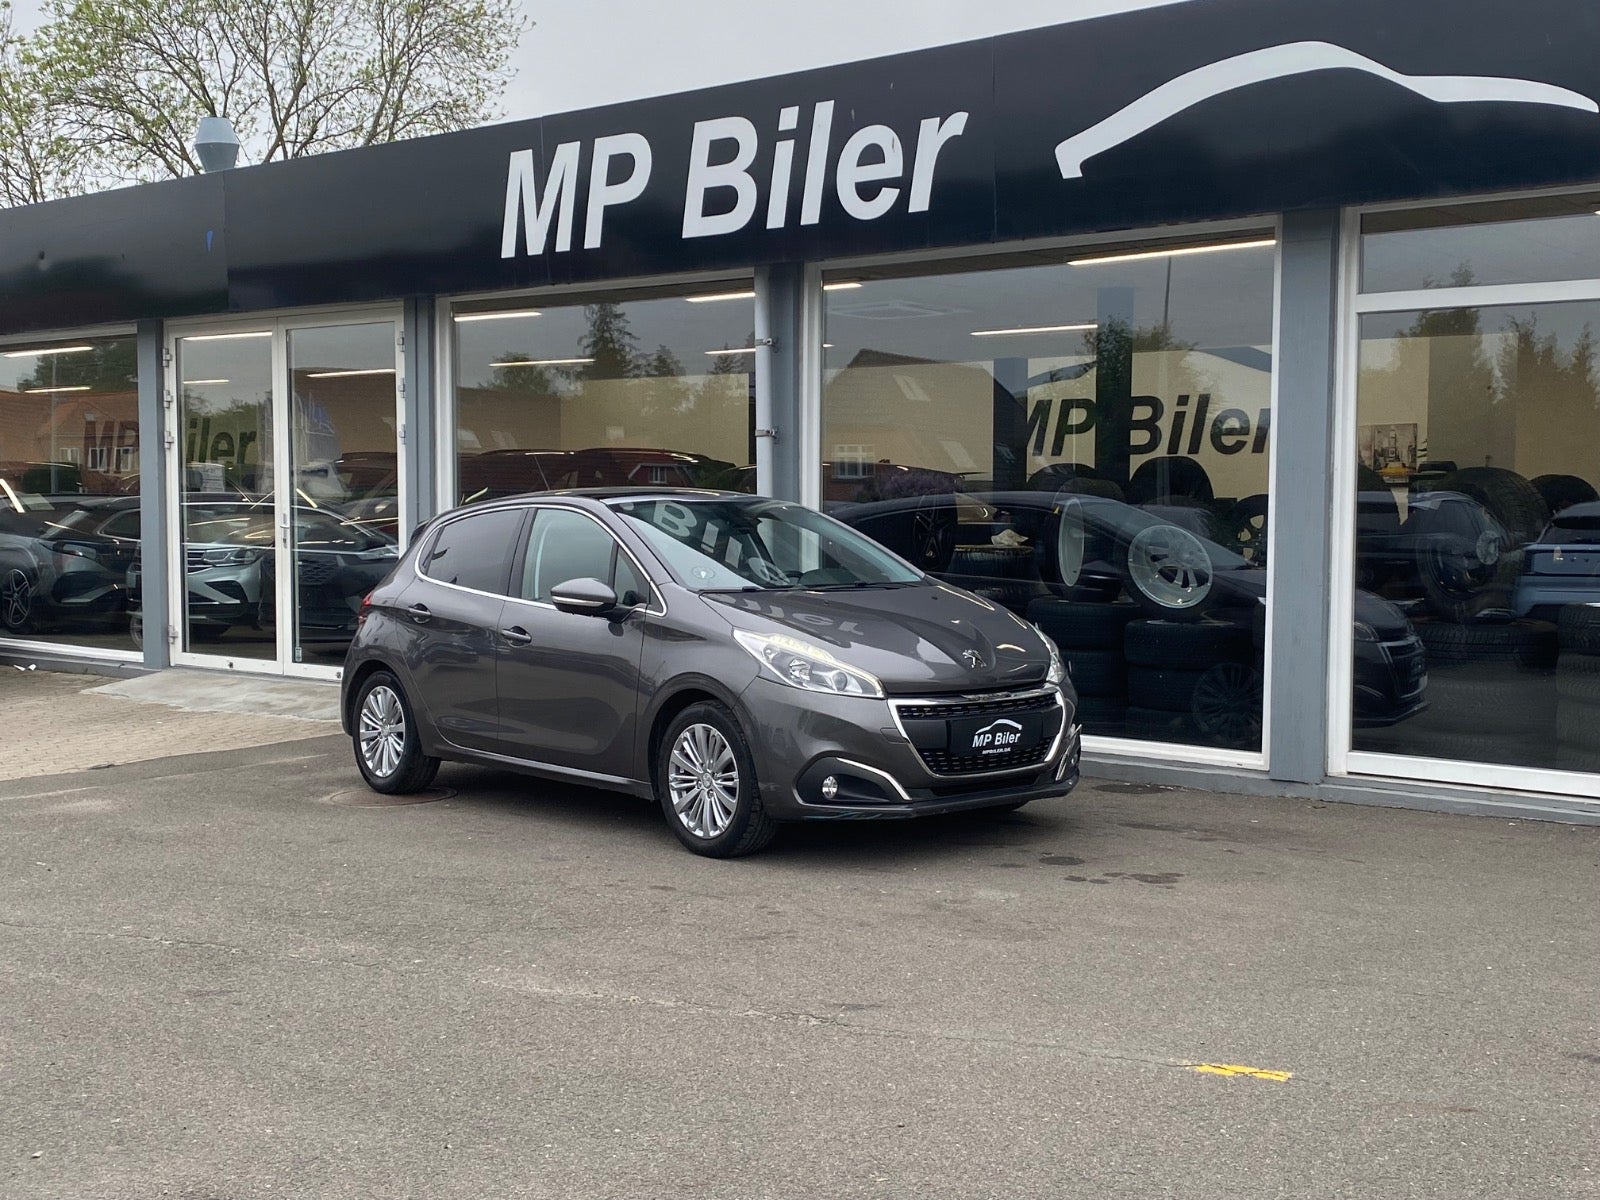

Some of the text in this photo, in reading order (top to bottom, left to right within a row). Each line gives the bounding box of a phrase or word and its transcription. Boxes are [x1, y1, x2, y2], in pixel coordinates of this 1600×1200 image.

[500, 99, 969, 259] MP Biler
[83, 417, 257, 473] MP iler
[972, 731, 1021, 747] MP Biler
